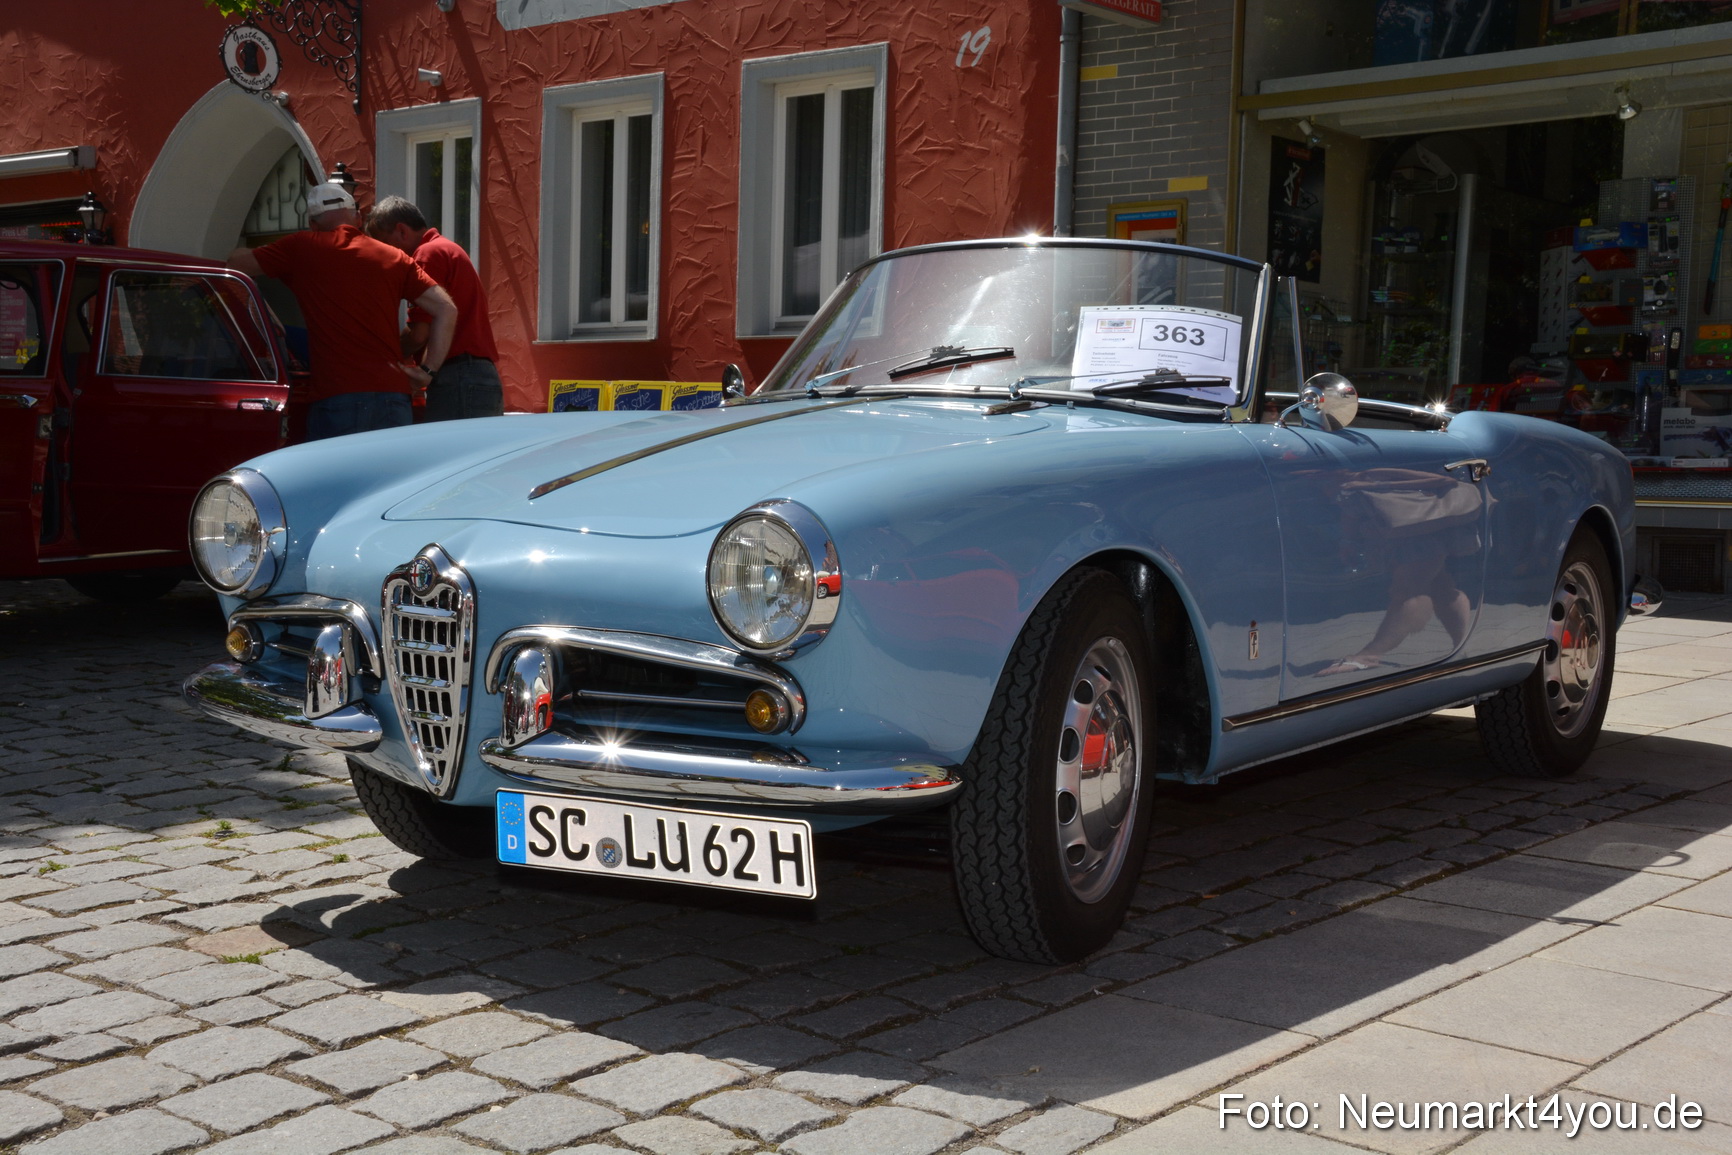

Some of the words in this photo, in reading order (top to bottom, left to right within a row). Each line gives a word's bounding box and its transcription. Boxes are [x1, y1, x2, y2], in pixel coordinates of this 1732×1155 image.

[232, 31, 270, 51] Gasthaus
[955, 26, 991, 68] 19
[1153, 324, 1206, 346] 363
[1663, 417, 1696, 425] metabo
[507, 834, 518, 850] D
[528, 804, 591, 862] SC
[623, 812, 691, 873] LU
